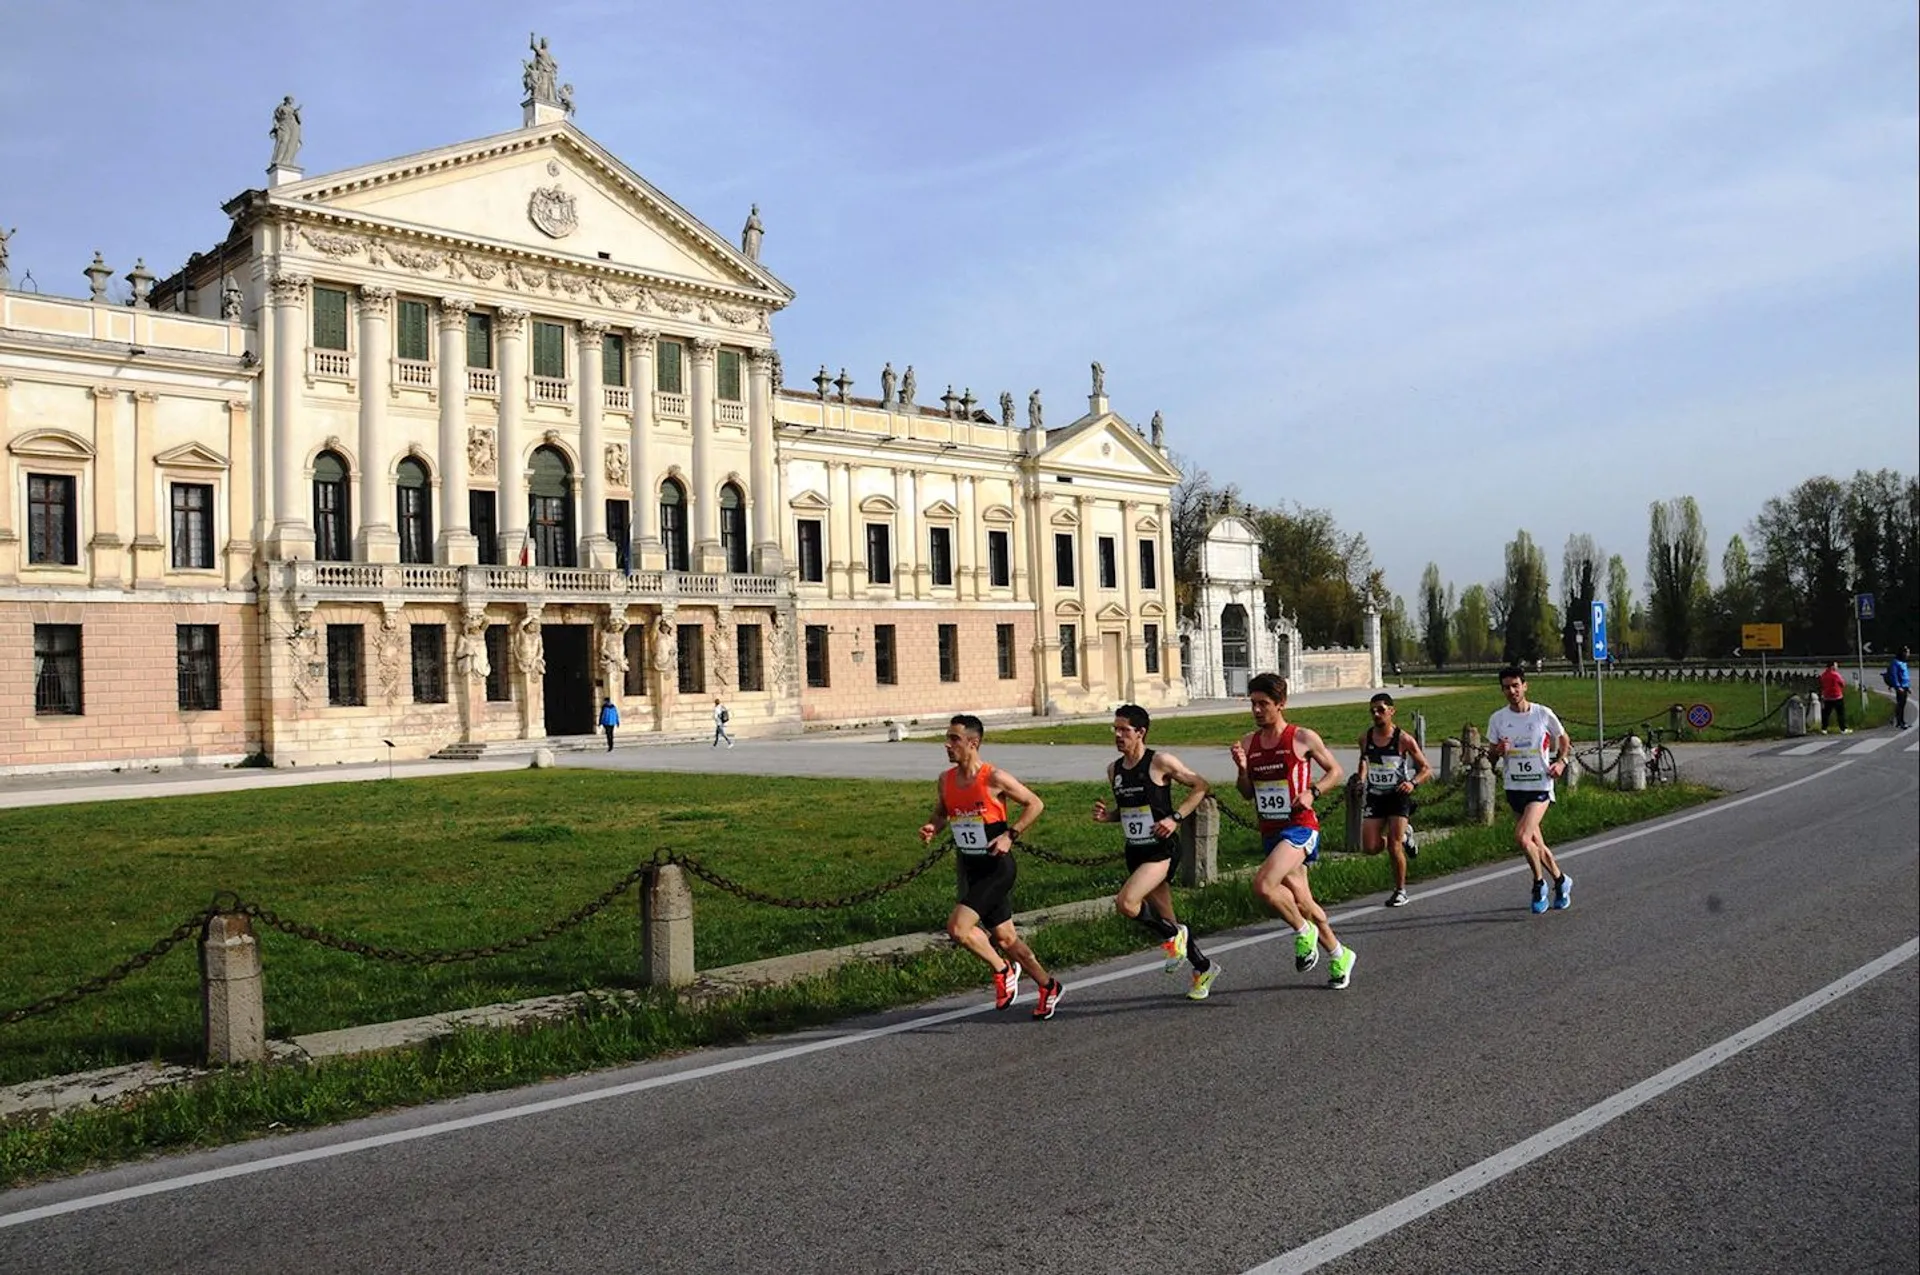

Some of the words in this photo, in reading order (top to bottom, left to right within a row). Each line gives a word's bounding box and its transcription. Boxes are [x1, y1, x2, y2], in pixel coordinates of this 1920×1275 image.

[1594, 605, 1603, 634] P
[1517, 761, 1532, 772] 16
[1370, 773, 1394, 783] 1387
[1260, 795, 1285, 809] 349
[1128, 822, 1143, 835] 87
[961, 831, 977, 844] 15
